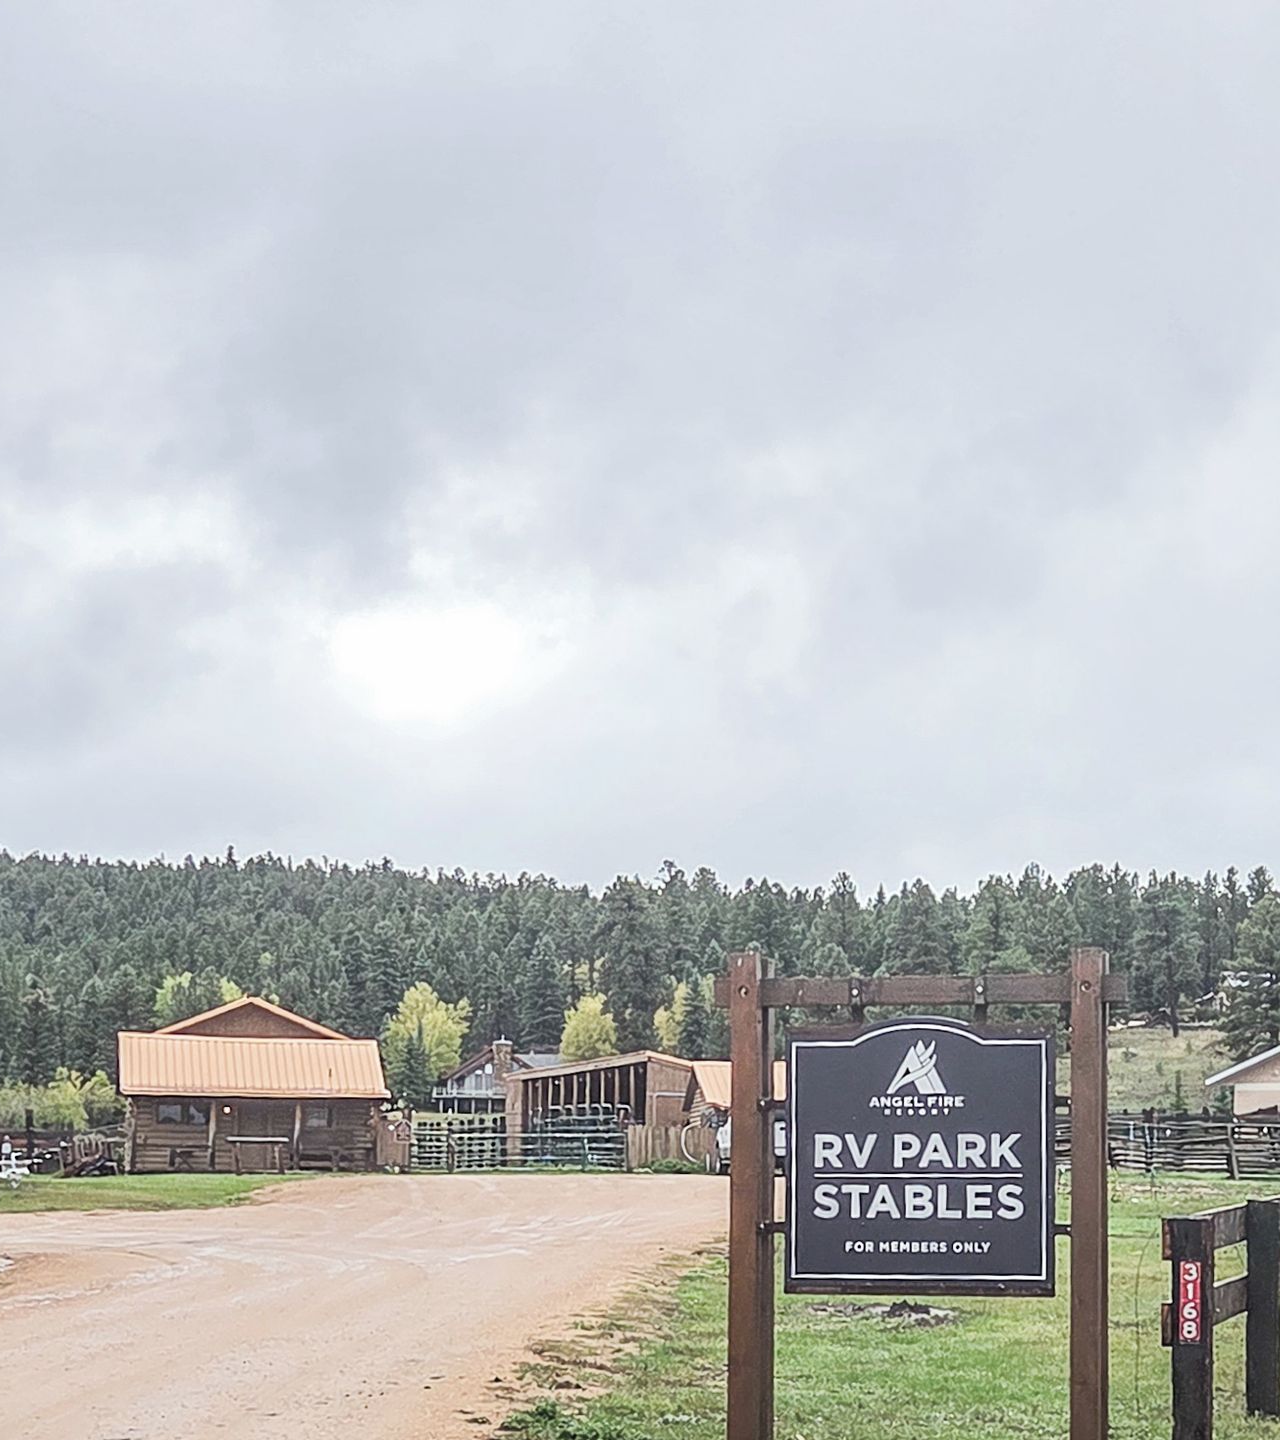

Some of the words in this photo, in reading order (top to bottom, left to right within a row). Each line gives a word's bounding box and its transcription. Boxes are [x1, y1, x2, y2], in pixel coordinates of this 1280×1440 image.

[869, 1096, 924, 1107] ANGEL
[927, 1096, 965, 1107] FIRE
[813, 1133, 877, 1168] RV
[893, 1133, 1022, 1168] PARK
[813, 1184, 1024, 1219] STABLES
[845, 1241, 874, 1252] FOR
[879, 1241, 947, 1253] MEMBERS
[952, 1241, 991, 1253] ONLY
[1182, 1264, 1197, 1338] 3168
